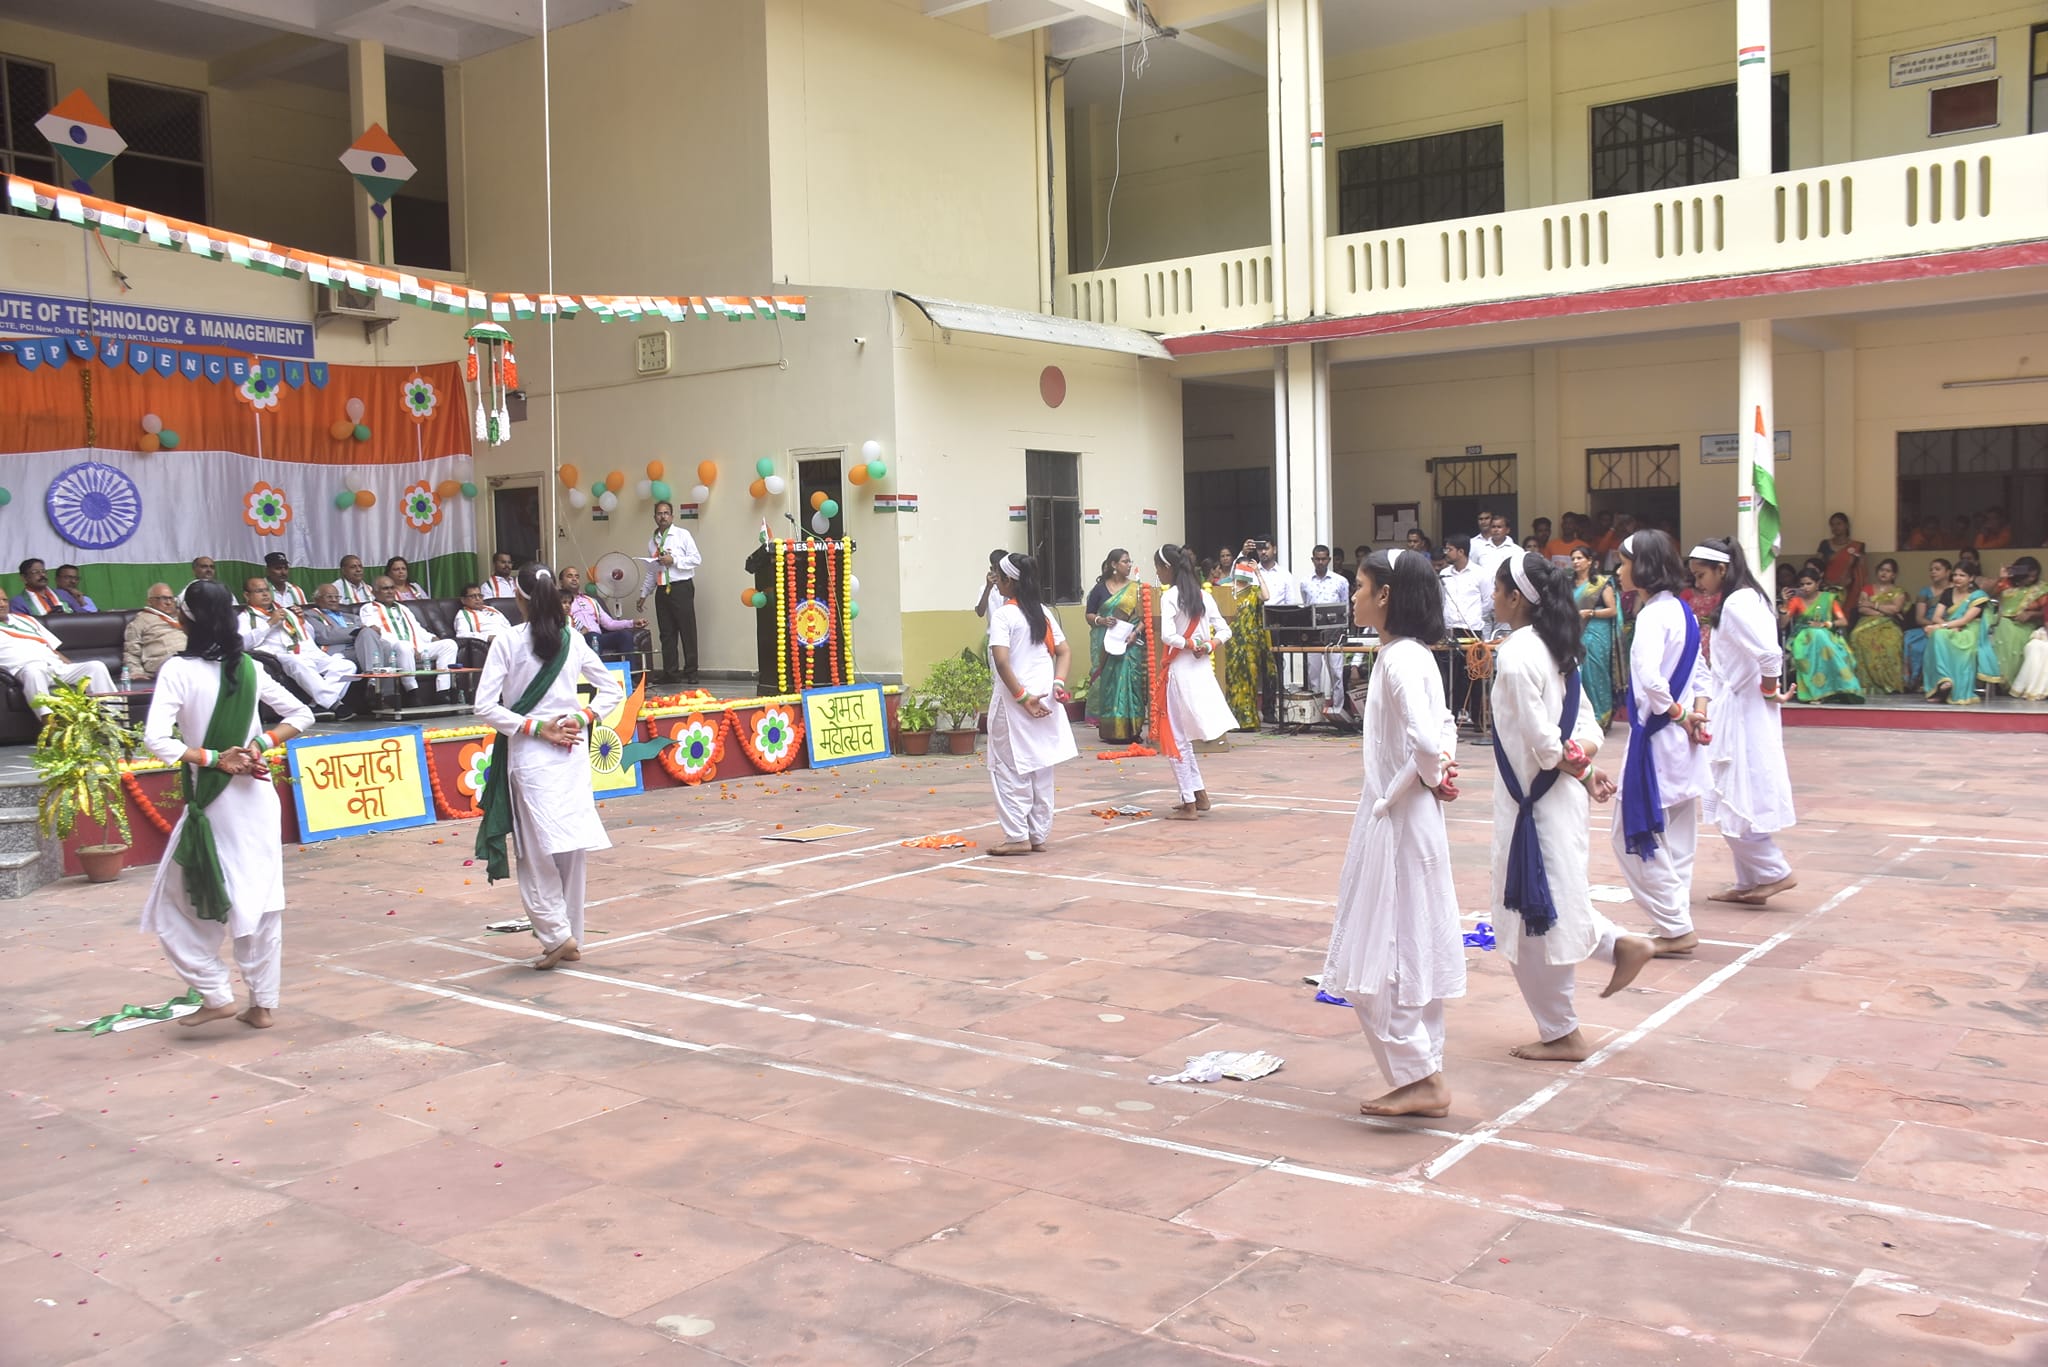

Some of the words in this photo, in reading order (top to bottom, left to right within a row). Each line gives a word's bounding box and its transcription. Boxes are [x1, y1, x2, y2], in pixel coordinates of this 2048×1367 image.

[37, 303, 61, 322] OF
[65, 306, 180, 334] TECHNOLOGY
[184, 318, 197, 336] &
[201, 319, 305, 345] MANAGEMENT
[265, 367, 323, 380] DAY
[819, 721, 875, 756] महोत्सव
[304, 738, 404, 790] आज़ादी
[347, 786, 388, 820] का
